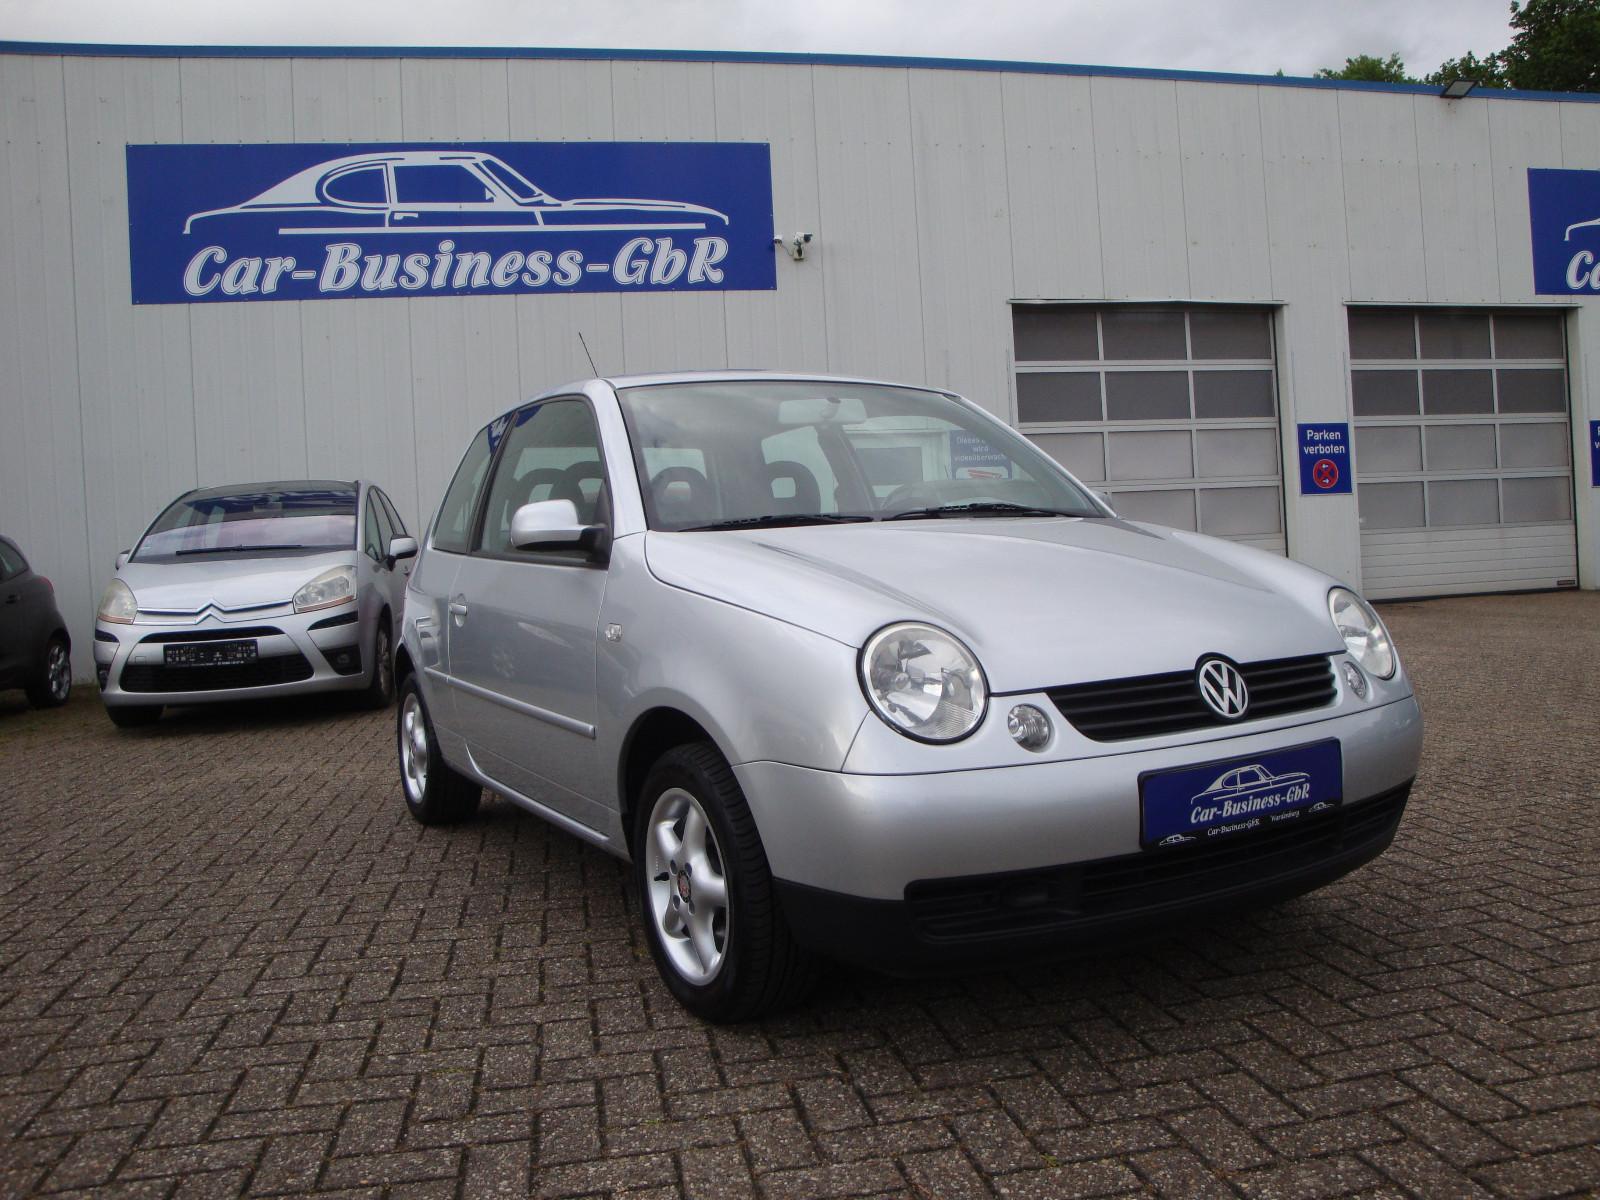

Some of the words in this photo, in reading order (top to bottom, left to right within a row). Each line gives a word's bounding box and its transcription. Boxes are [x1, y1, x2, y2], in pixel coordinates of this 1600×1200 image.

[183, 236, 729, 296] Car-Business-GbR
[1304, 443, 1345, 454] verboten
[1306, 429, 1341, 440] Parken
[1199, 660, 1248, 718] VW
[1190, 783, 1311, 824] Car-Business-GbR
